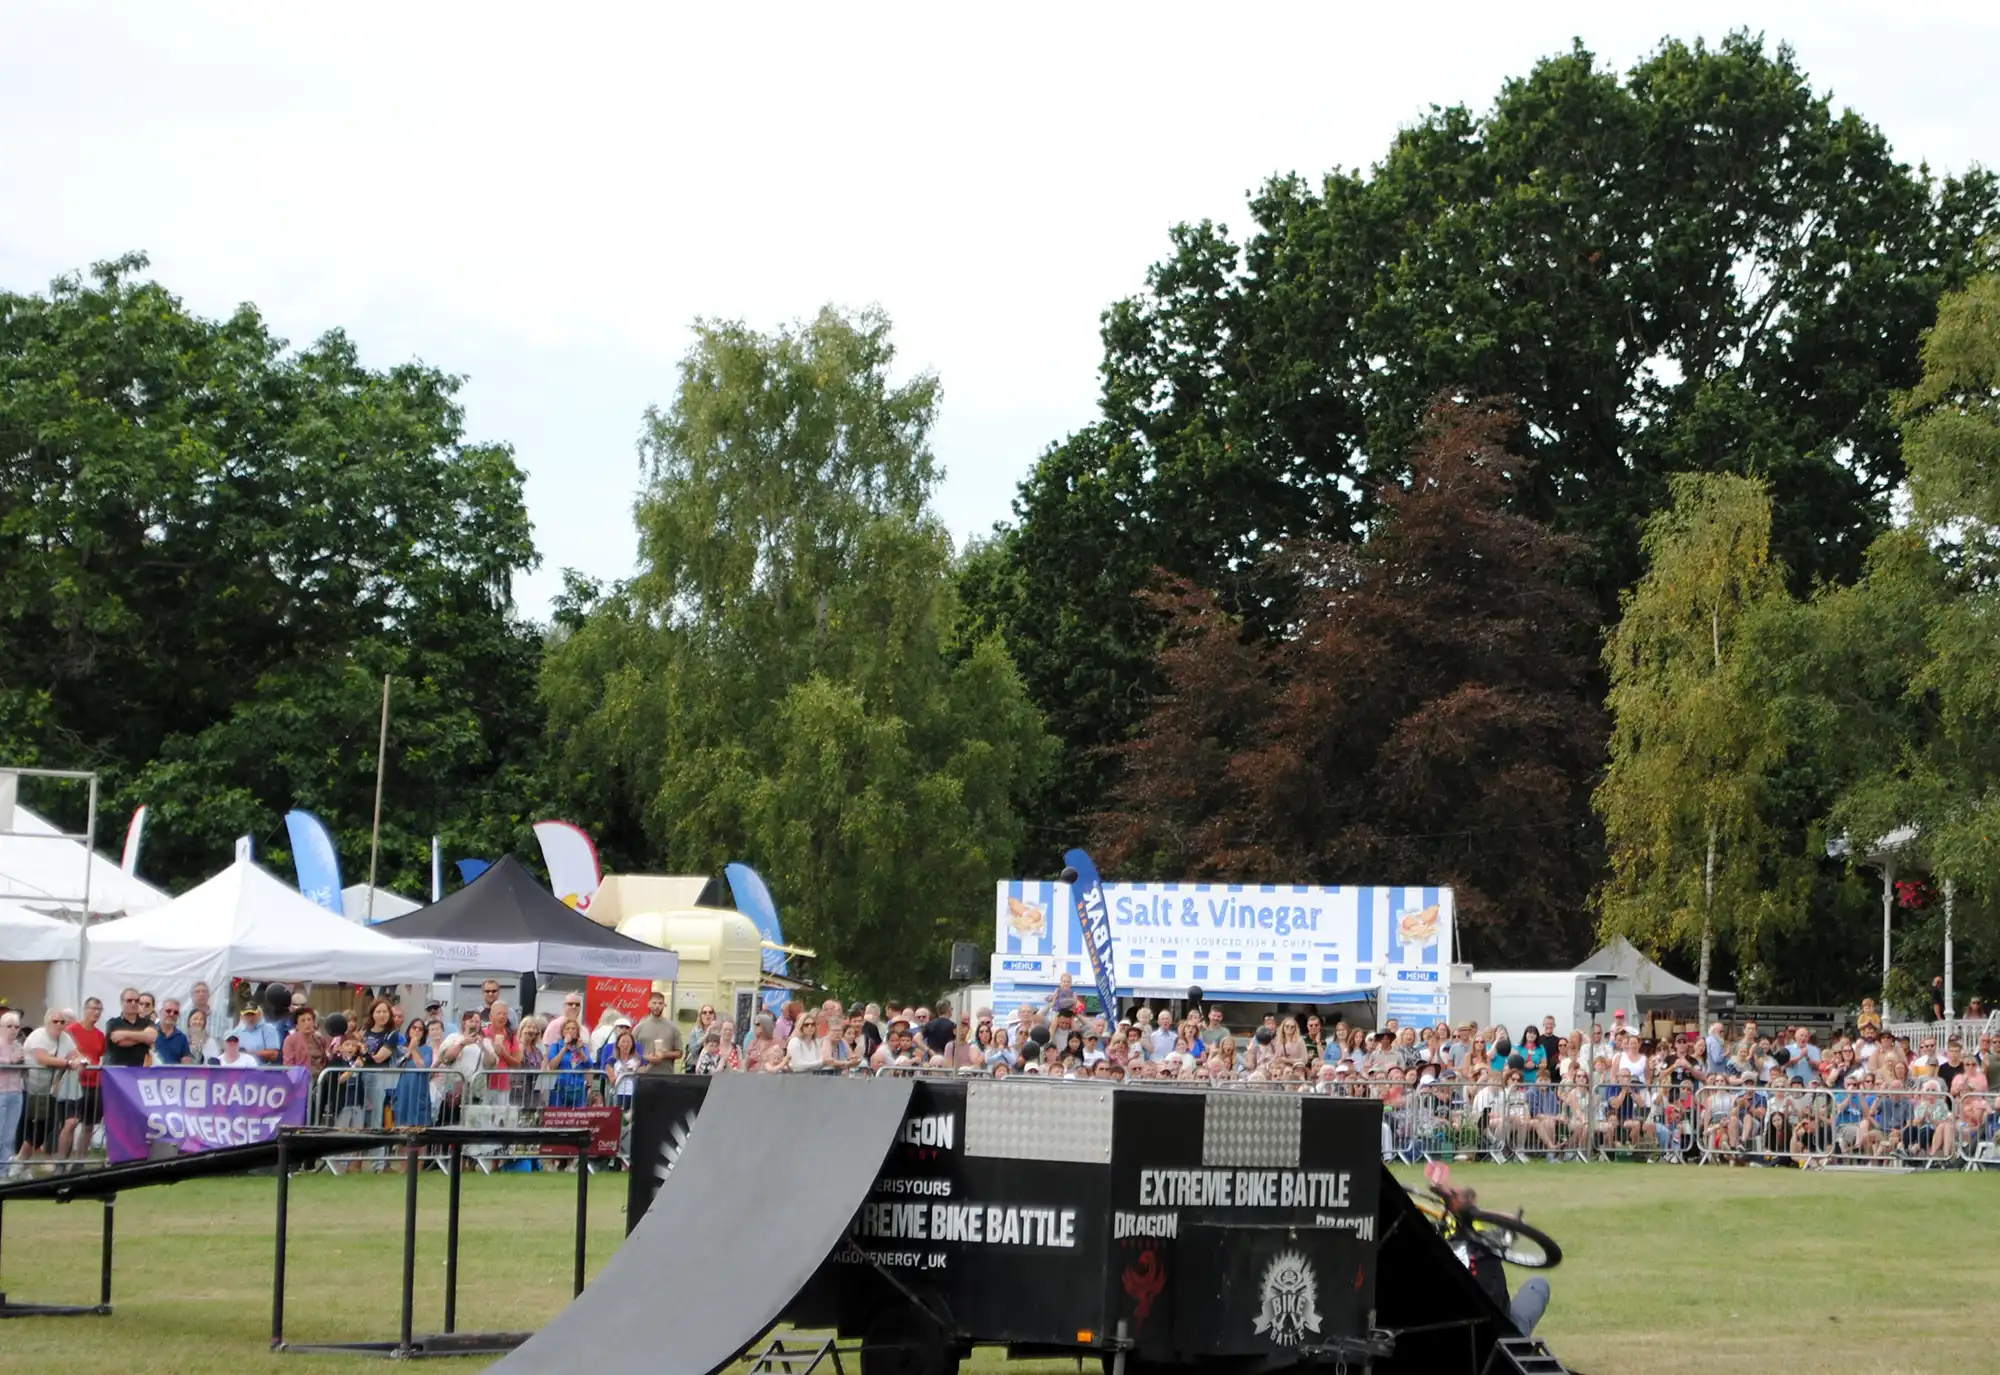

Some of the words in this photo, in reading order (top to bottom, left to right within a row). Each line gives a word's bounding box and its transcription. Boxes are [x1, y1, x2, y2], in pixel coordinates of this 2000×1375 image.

[1116, 895, 1173, 927] Salt
[1181, 896, 1199, 927] &
[1207, 897, 1323, 937] Vinegar
[1126, 935, 1190, 945] SUSTAINABLY
[1195, 937, 1241, 947] SOURCED
[1246, 938, 1267, 947] FISH
[1271, 939, 1277, 947] &
[1282, 939, 1313, 948] CHIPS
[1010, 961, 1034, 971] MENU
[1405, 971, 1430, 981] MENU
[211, 1083, 286, 1109] RADIO
[146, 1112, 283, 1145] SOMERSET
[901, 1114, 954, 1150] GON
[1140, 1170, 1233, 1206] EXTREME
[1235, 1171, 1278, 1207] BIKE
[1280, 1172, 1350, 1208] BATTLE
[931, 1204, 983, 1243] BIKE
[986, 1207, 1076, 1248] BATTLE
[1114, 1212, 1178, 1239] DRAGON
[1272, 1294, 1306, 1316] BIKE
[1269, 1327, 1305, 1347] BATTLE
